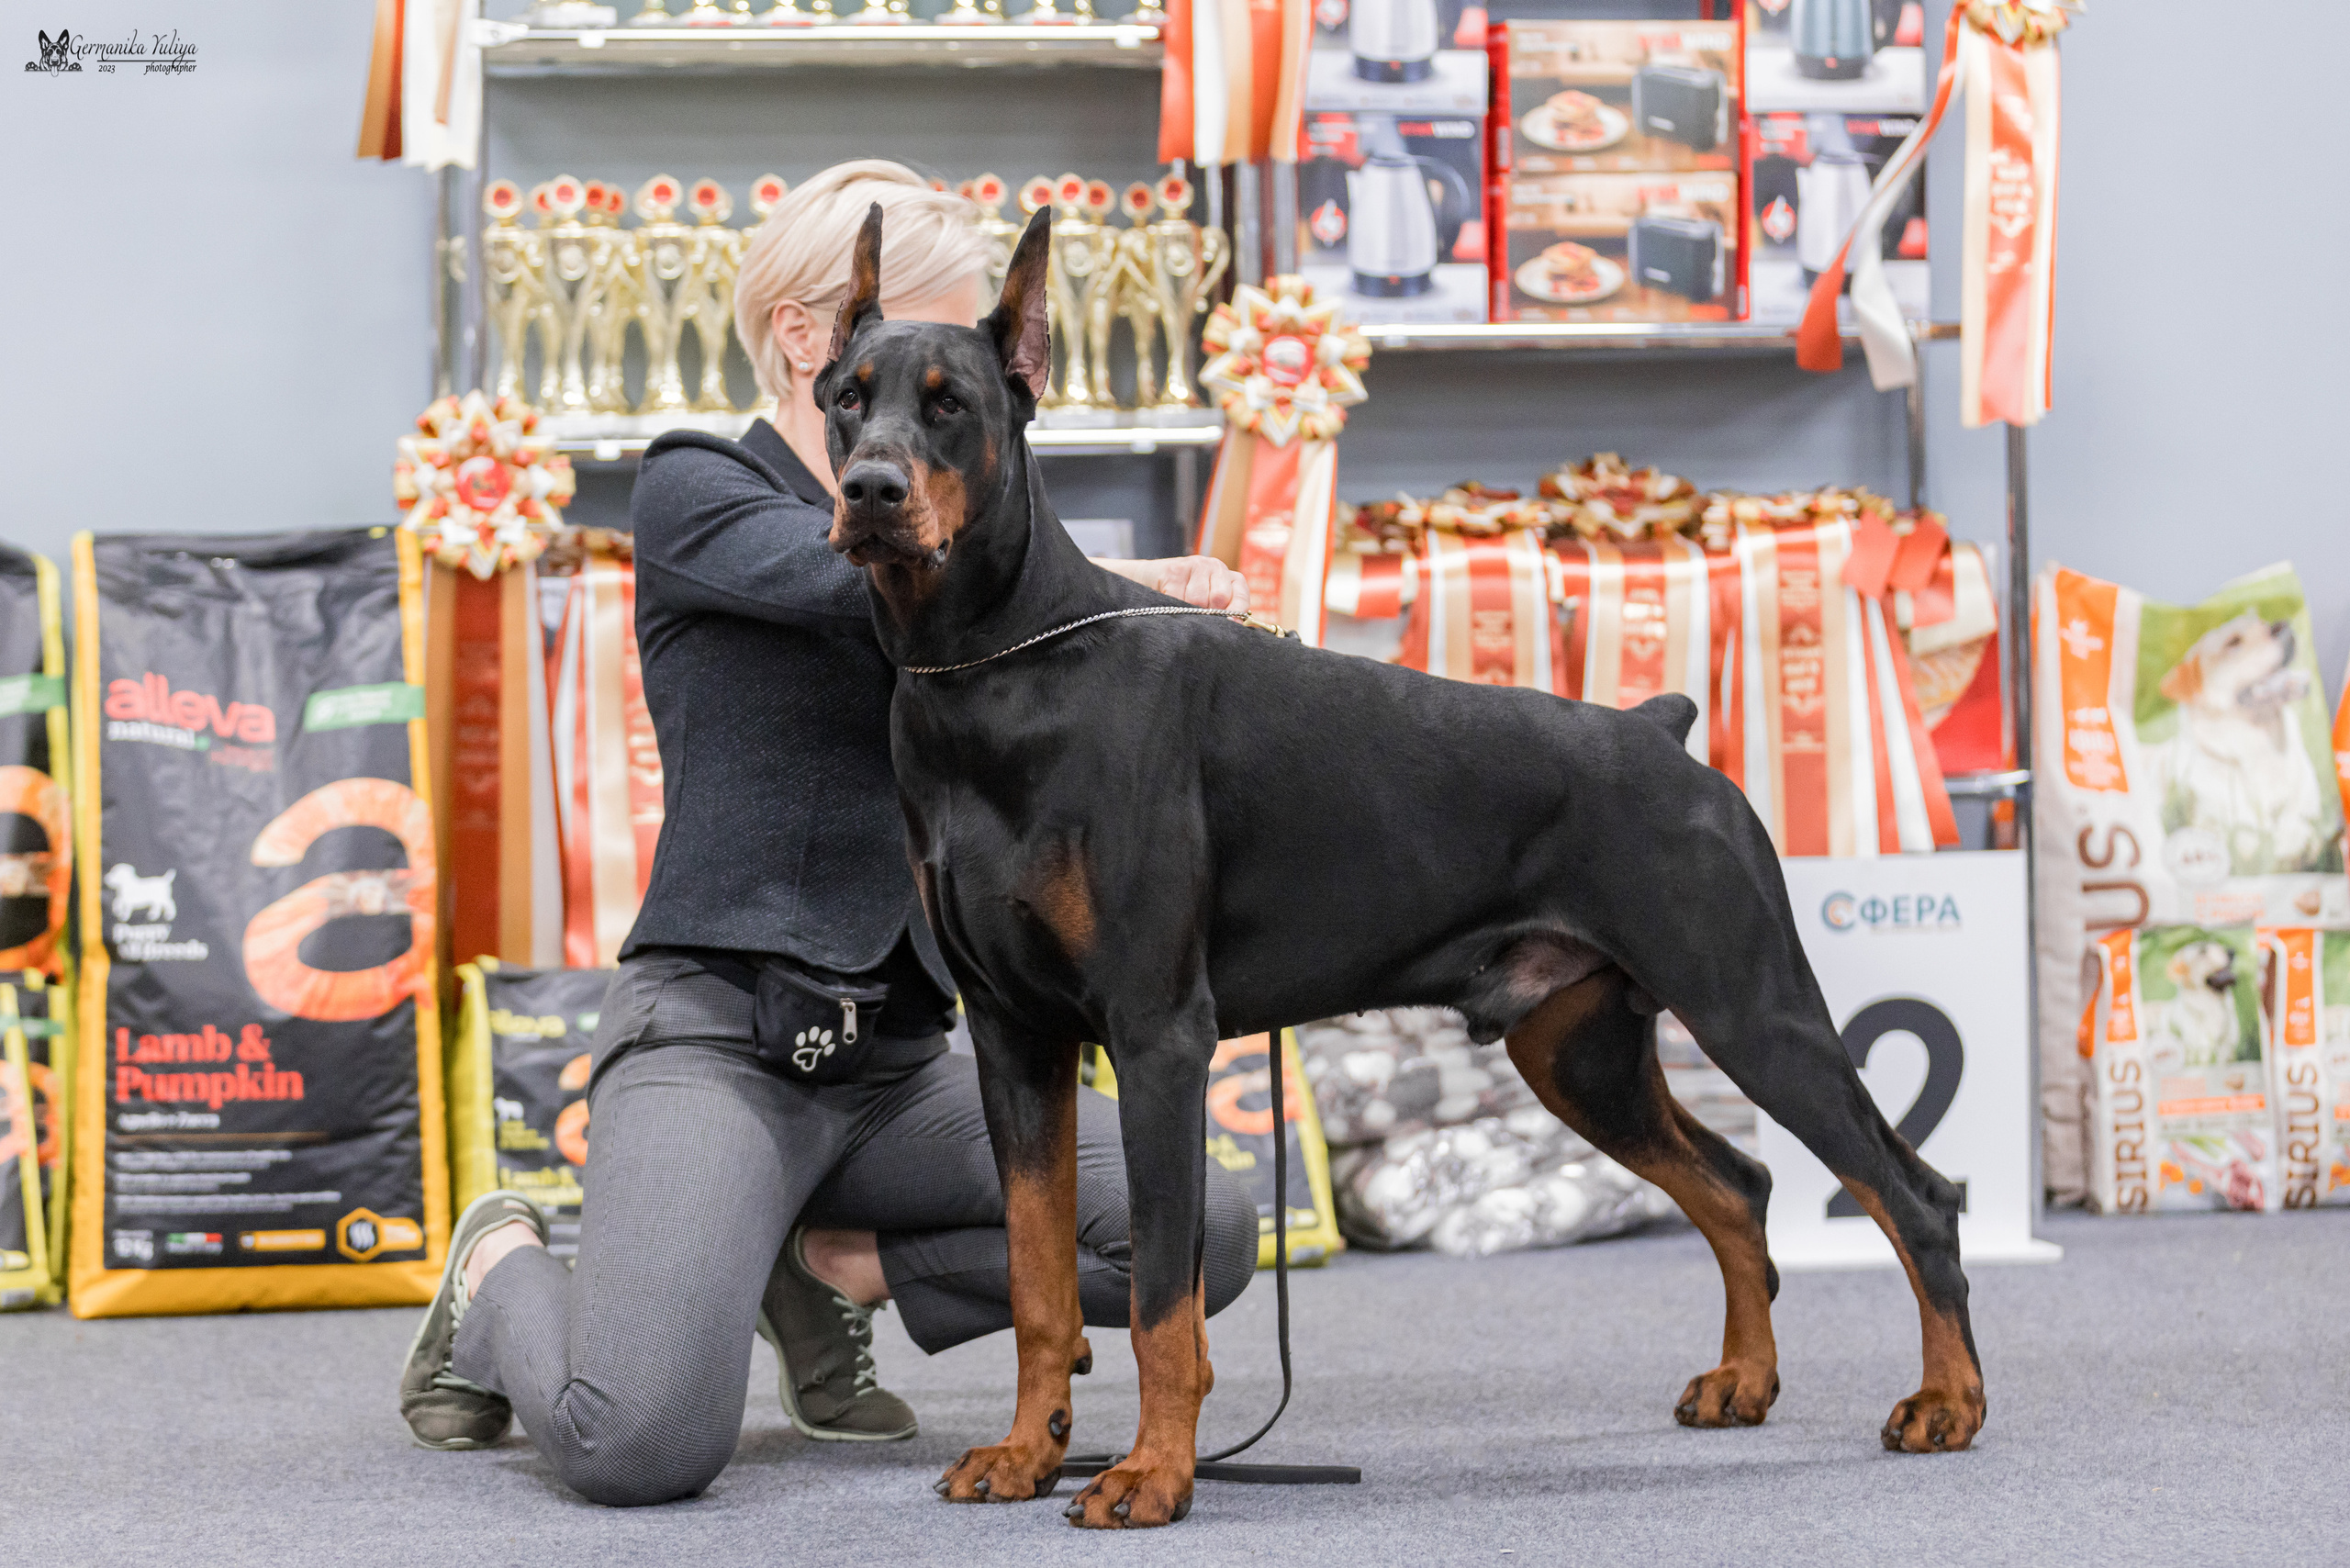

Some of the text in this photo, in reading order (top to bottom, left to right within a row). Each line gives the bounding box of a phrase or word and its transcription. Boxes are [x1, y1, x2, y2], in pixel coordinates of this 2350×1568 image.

[105, 671, 275, 744] alleva
[116, 1024, 272, 1064] Lamb &
[116, 1061, 304, 1110] Pumpkin
[1827, 998, 1967, 1217] 2
[2109, 1058, 2149, 1215] SIRIUS
[2284, 1063, 2320, 1210] SIRIUS
